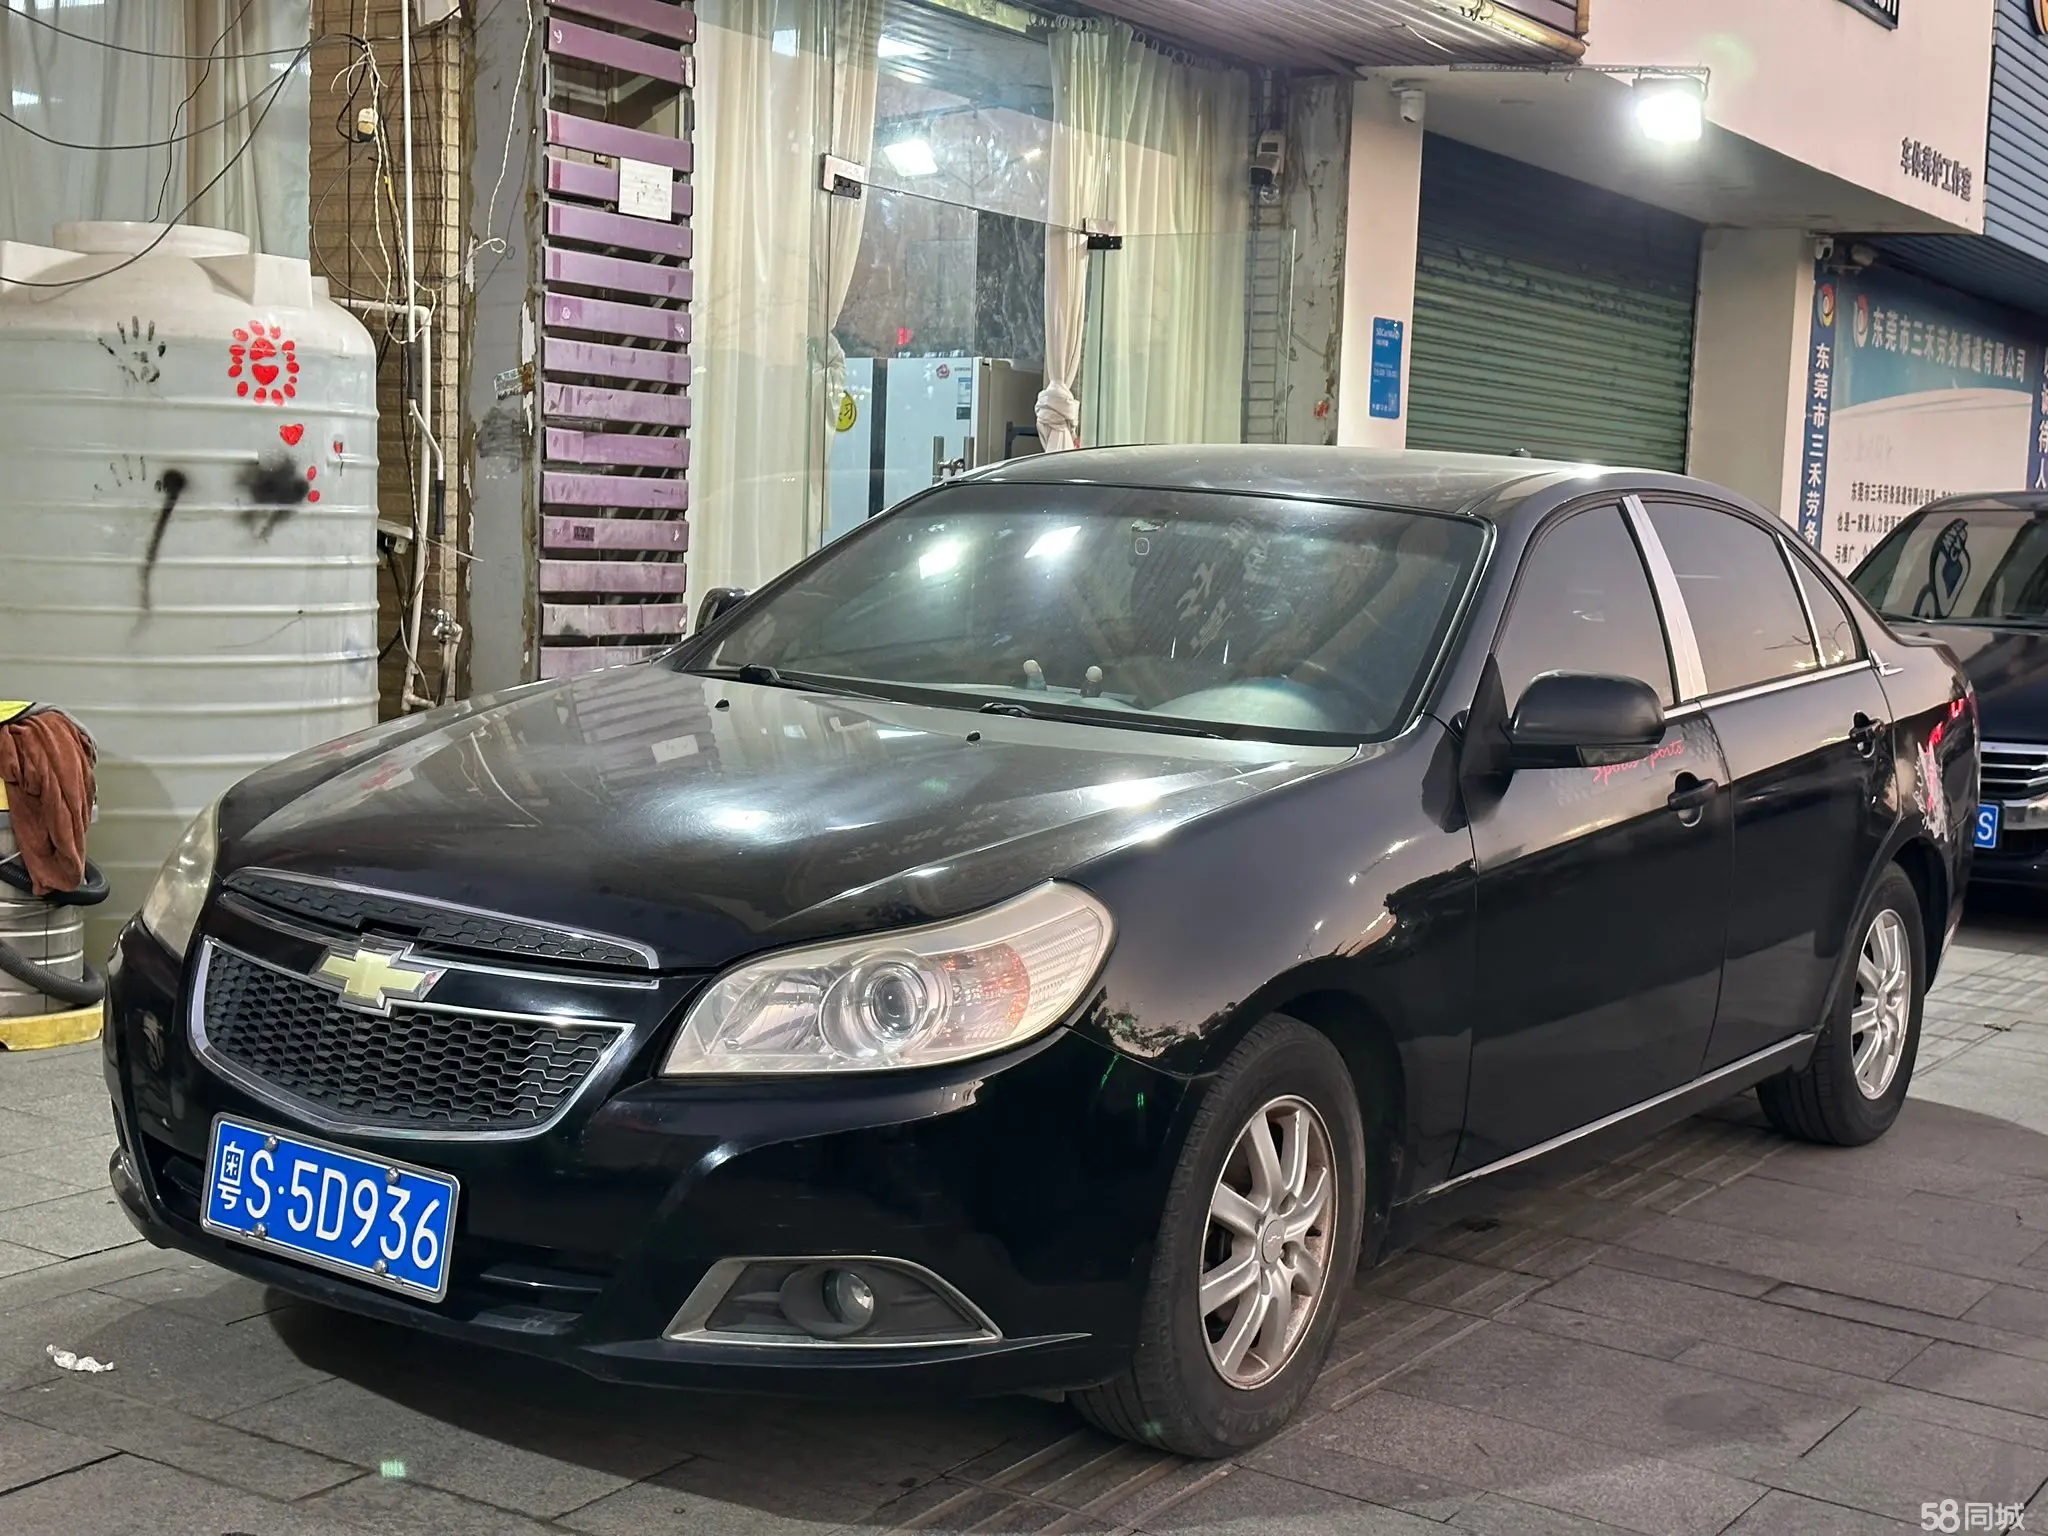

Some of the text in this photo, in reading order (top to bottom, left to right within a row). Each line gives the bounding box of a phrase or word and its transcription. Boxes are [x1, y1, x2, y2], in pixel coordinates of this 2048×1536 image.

[1872, 306, 2026, 383] 东莞市三禾劳务派遣有限公司
[1804, 342, 1830, 545] 东莞市三禾劳务
[217, 1140, 441, 1270] 粤S·5D936
